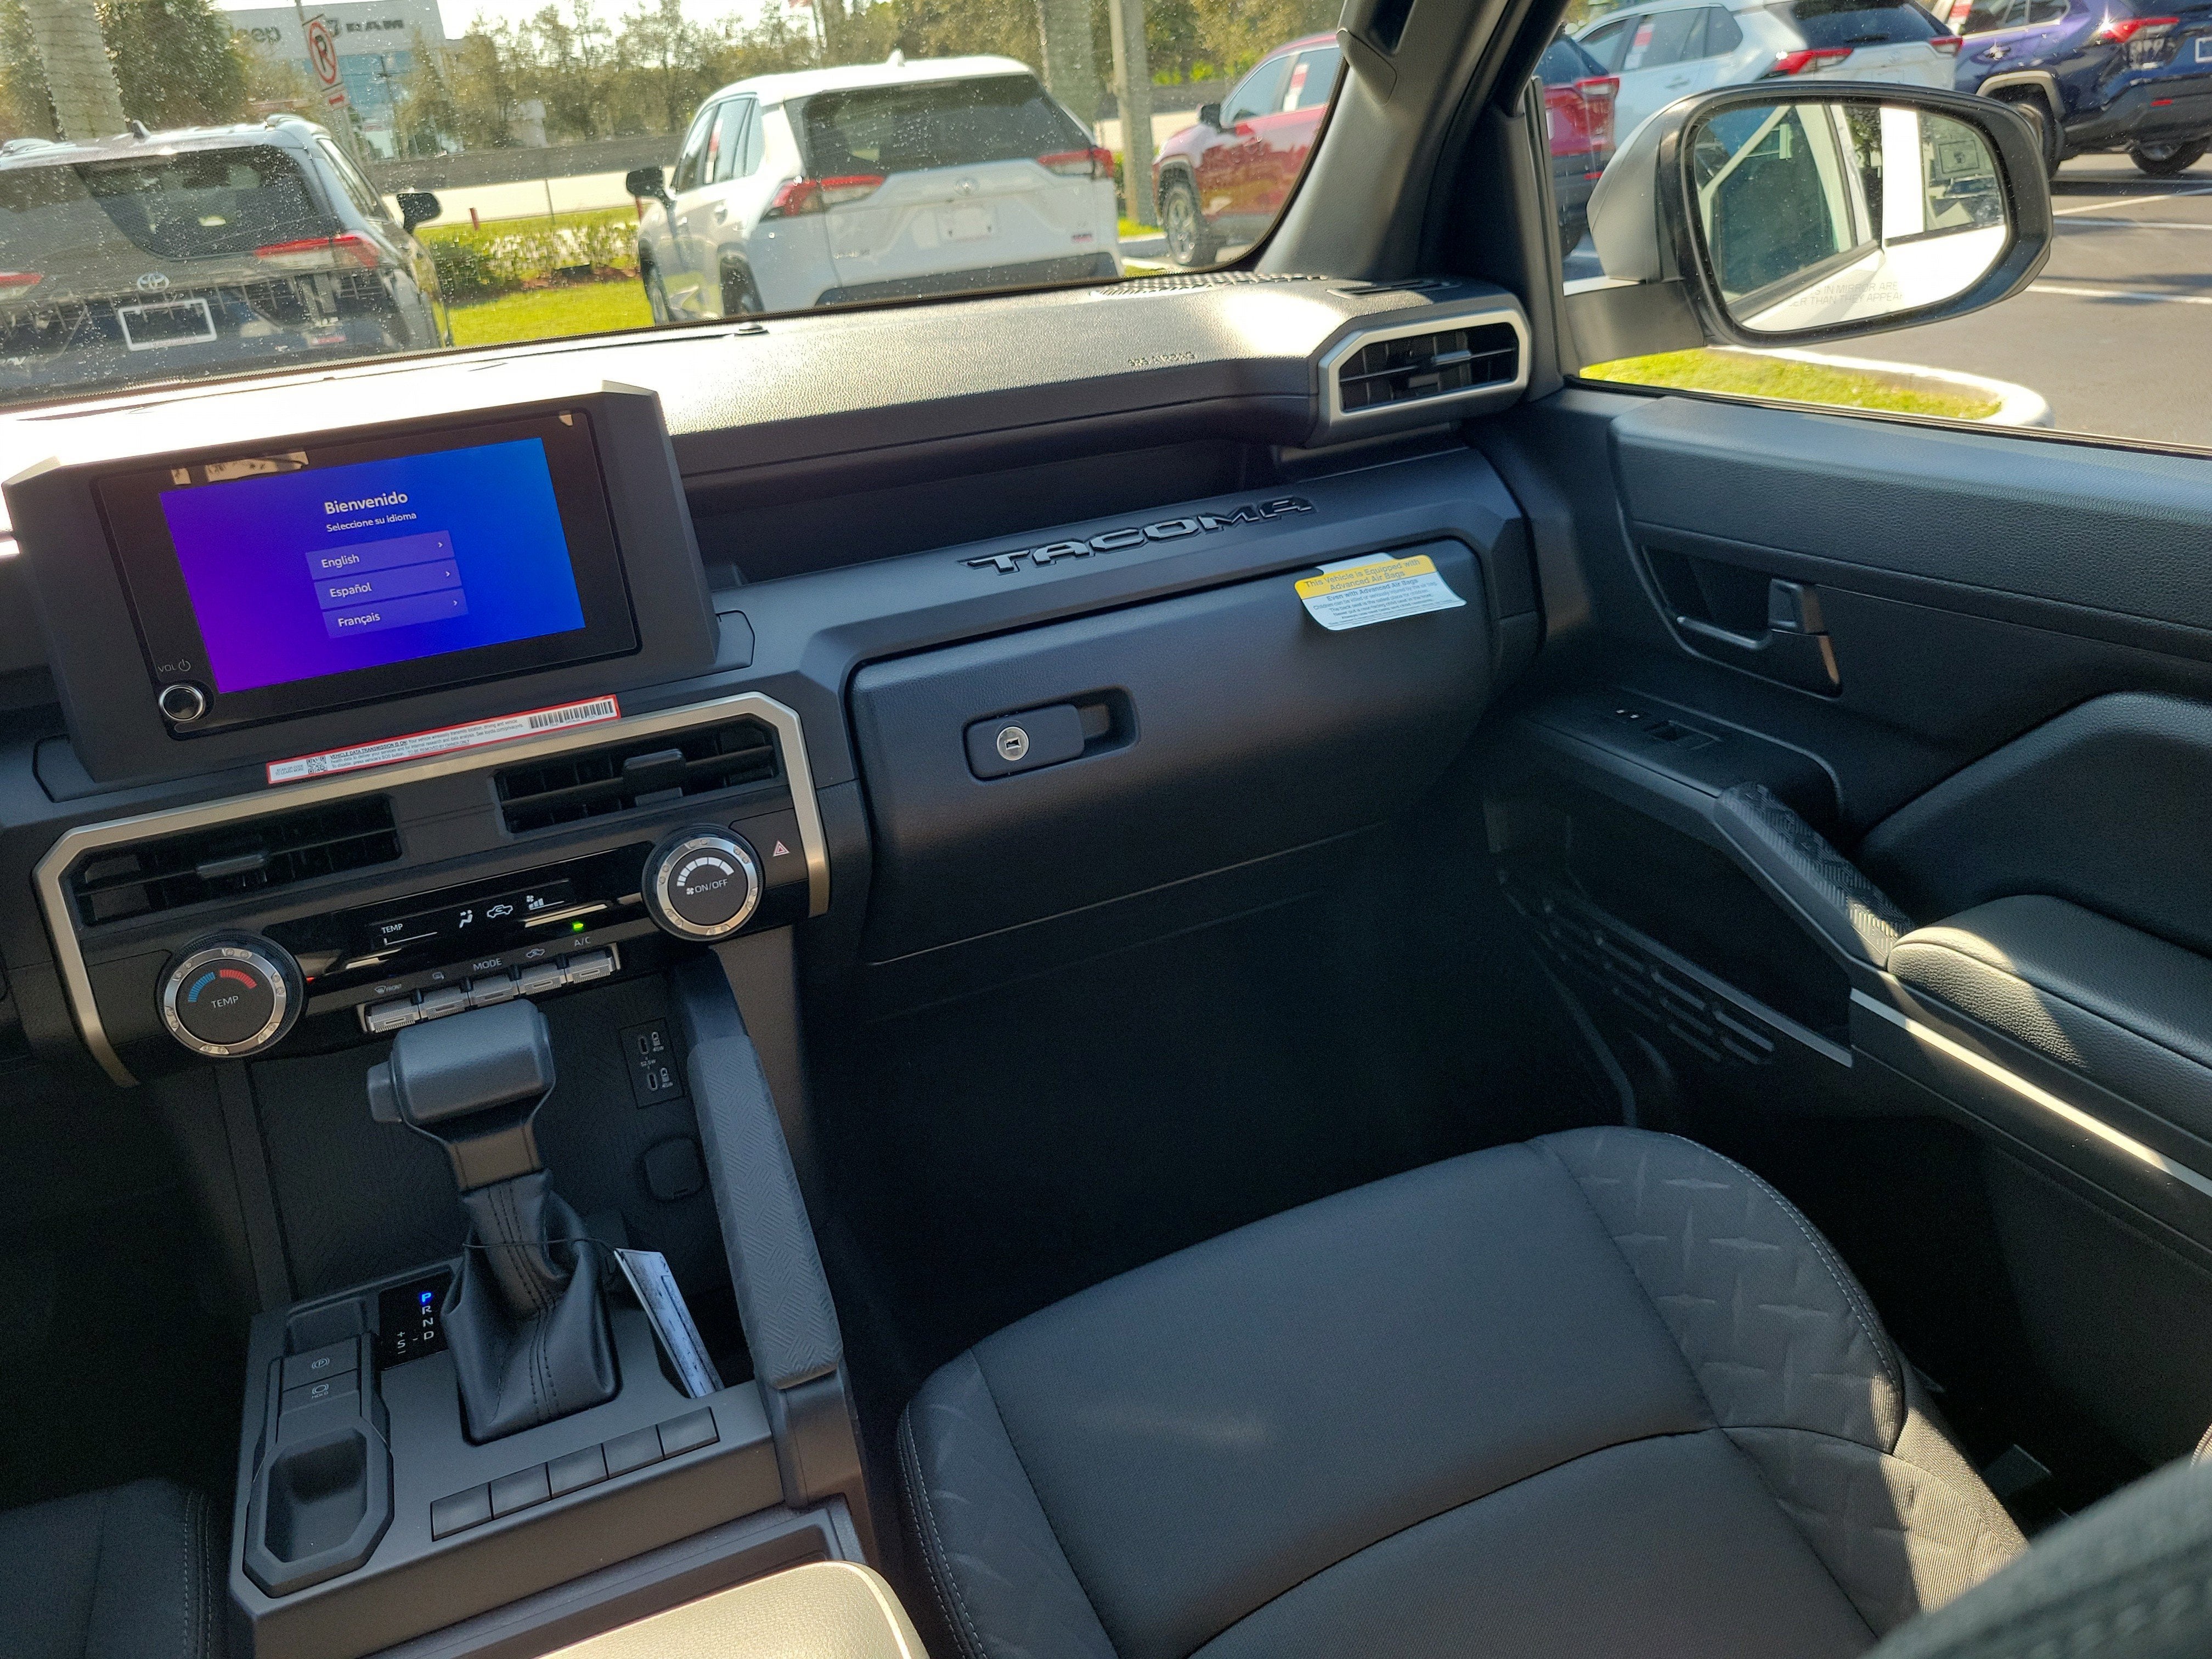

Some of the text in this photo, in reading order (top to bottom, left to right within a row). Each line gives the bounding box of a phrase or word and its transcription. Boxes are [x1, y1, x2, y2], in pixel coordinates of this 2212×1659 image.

[315, 35, 328, 71] P
[1836, 283, 1876, 294] MIRROR
[1879, 281, 1898, 291] ARE
[1810, 295, 1836, 306] THAN
[1839, 292, 1864, 303] THEY
[1152, 351, 1195, 363] AIRBAG
[324, 492, 408, 515] Bienvenido
[326, 512, 417, 532] Seleccione su idioma
[964, 495, 1314, 573] TACOMA
[321, 554, 360, 568] English
[1304, 579, 1323, 588] This
[1324, 573, 1355, 583] Vehicle
[1364, 562, 1402, 575] Equipped
[1330, 577, 1370, 591] Advanced
[1385, 571, 1405, 579] Bags
[330, 583, 372, 598] Español
[1359, 584, 1391, 594] Advanced
[338, 612, 381, 627] Français
[158, 664, 176, 672] VOL
[362, 742, 394, 753] TRANSMISSION
[695, 878, 727, 893] ON/OFF
[381, 923, 403, 934] TEMP
[574, 936, 591, 946] A/C
[472, 958, 503, 971] MODE
[211, 996, 239, 1008] TEMP
[422, 1292, 432, 1303] P
[422, 1305, 433, 1314] R
[423, 1317, 433, 1328] N
[424, 1331, 434, 1340] D
[397, 1339, 406, 1349] S
